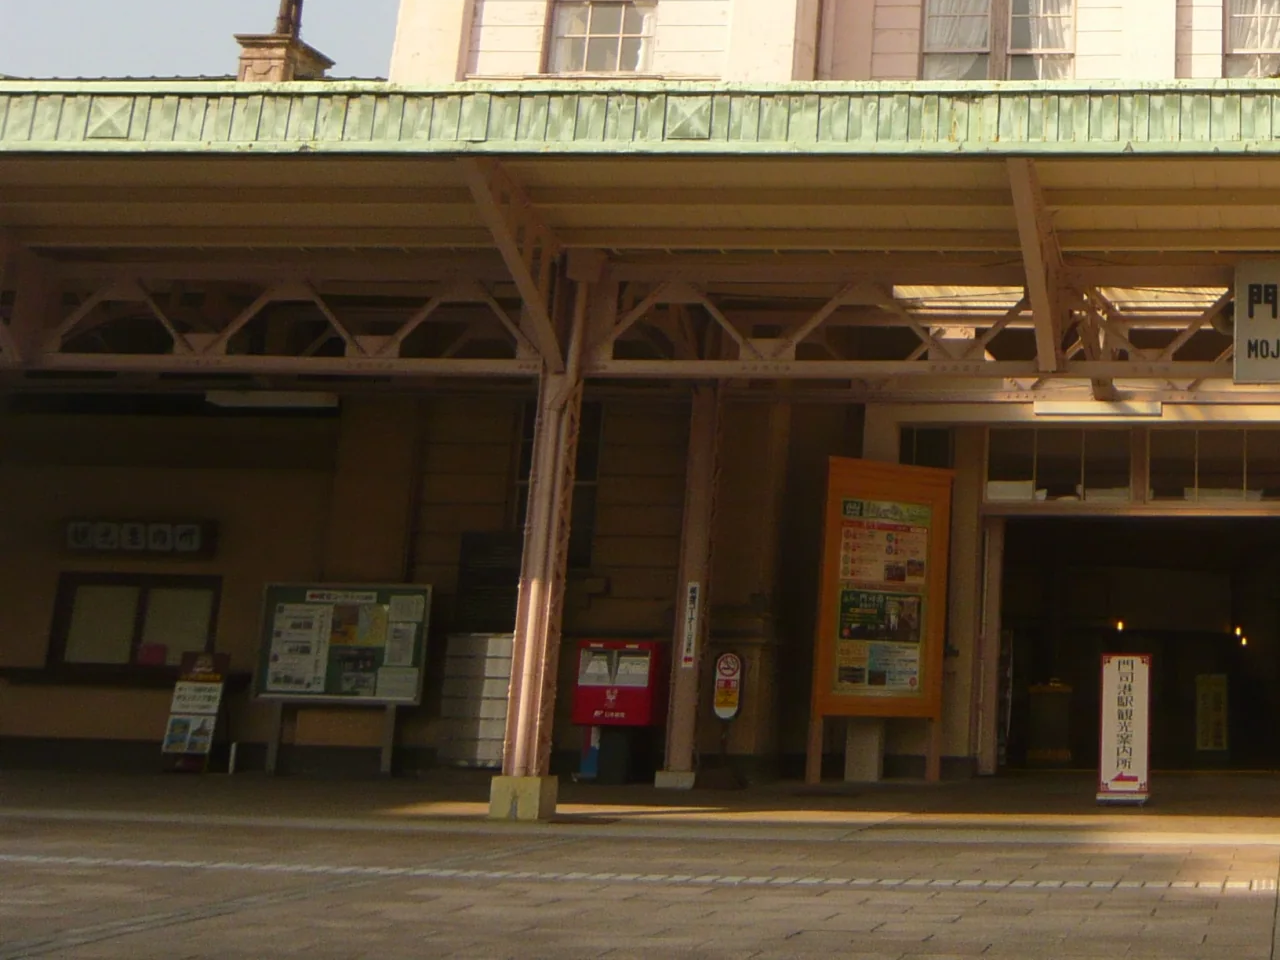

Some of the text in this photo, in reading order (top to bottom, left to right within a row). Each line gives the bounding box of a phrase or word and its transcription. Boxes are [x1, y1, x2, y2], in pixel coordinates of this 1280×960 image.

[1116, 659, 1134, 769] 門司港駅観光案内所
